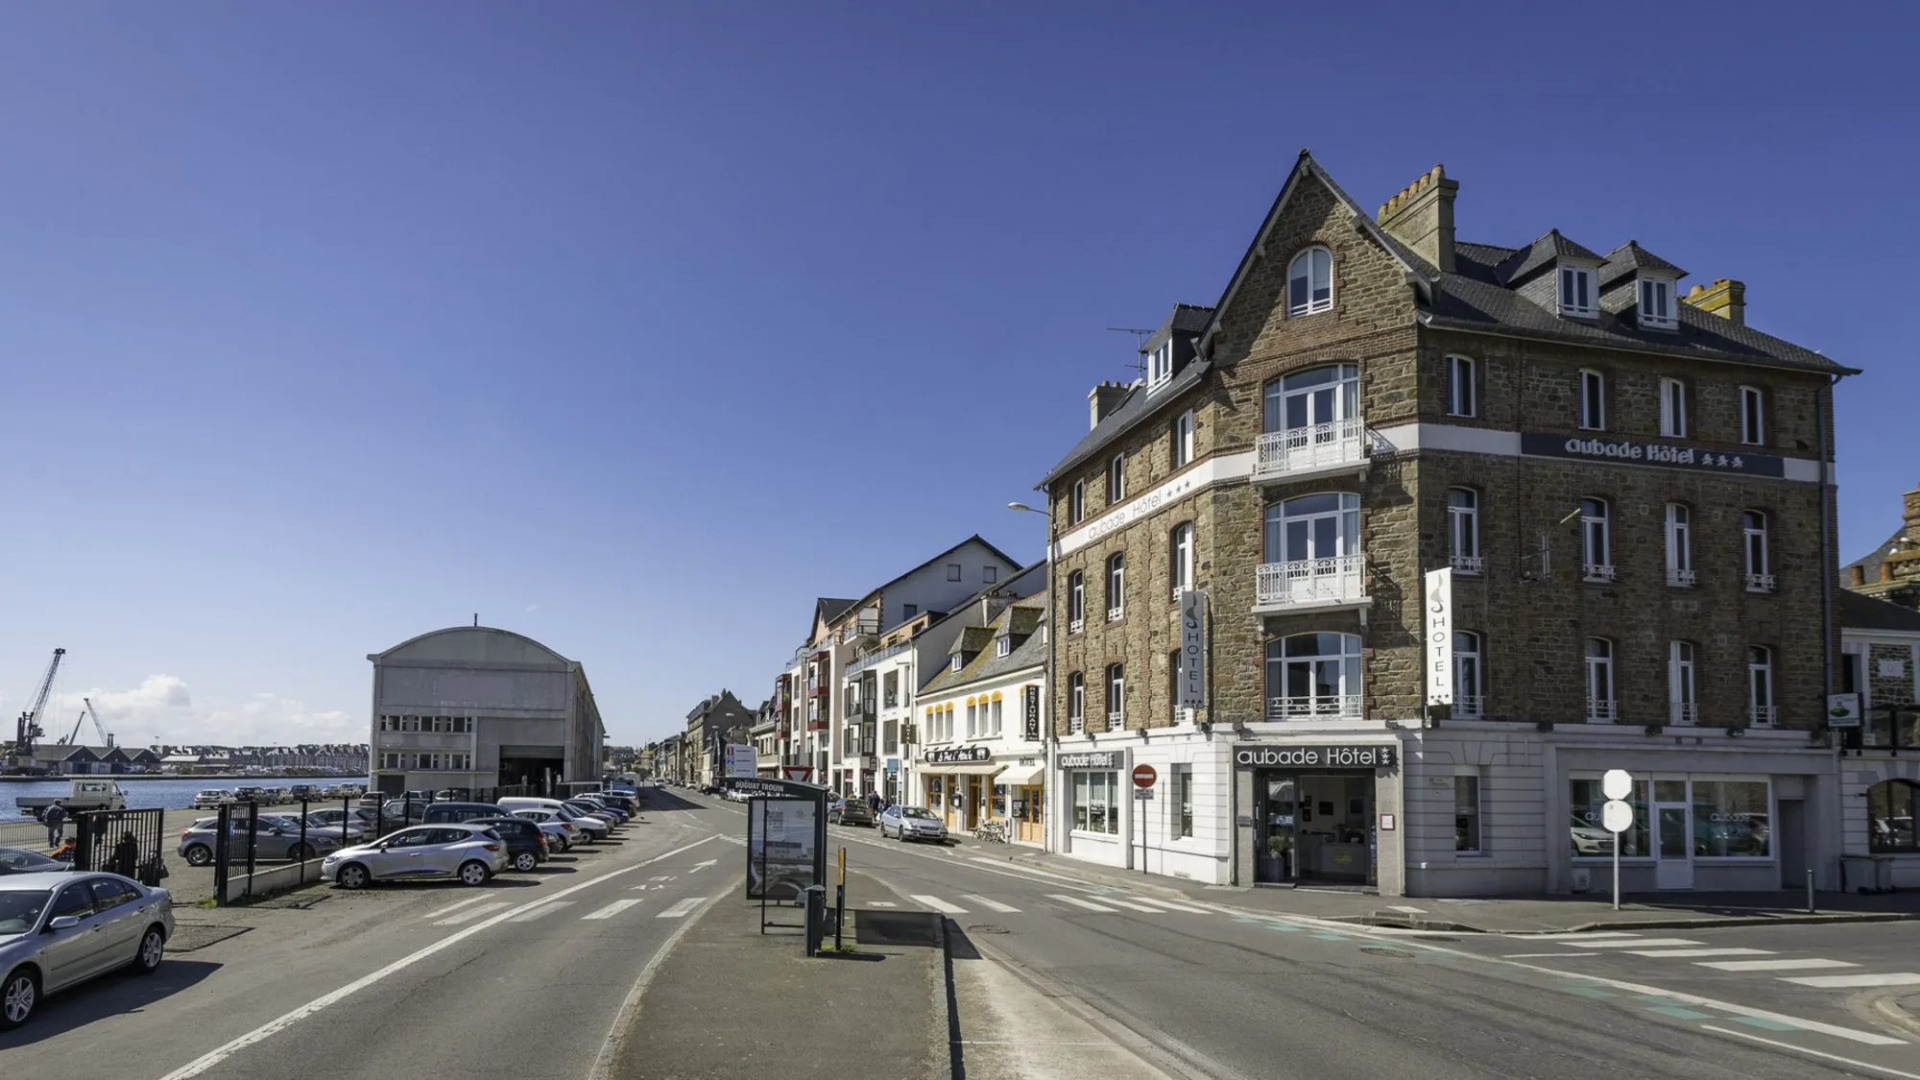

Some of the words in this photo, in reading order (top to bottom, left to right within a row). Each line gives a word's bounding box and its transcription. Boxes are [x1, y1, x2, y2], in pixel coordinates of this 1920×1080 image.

[1565, 438, 1642, 459] aubade
[1646, 444, 1694, 464] Hôtel
[1088, 511, 1126, 539] aubade
[1132, 490, 1162, 515] Hôtel
[1187, 632, 1199, 693] HOTEL
[1432, 616, 1445, 687] HOTEL
[1029, 687, 1037, 732] RESTAURANT
[1061, 754, 1090, 766] aubade
[1237, 748, 1318, 765] aubade
[1327, 747, 1377, 765] Hôtel
[735, 781, 760, 790] DUGUAY
[761, 782, 785, 792] TROUIN
